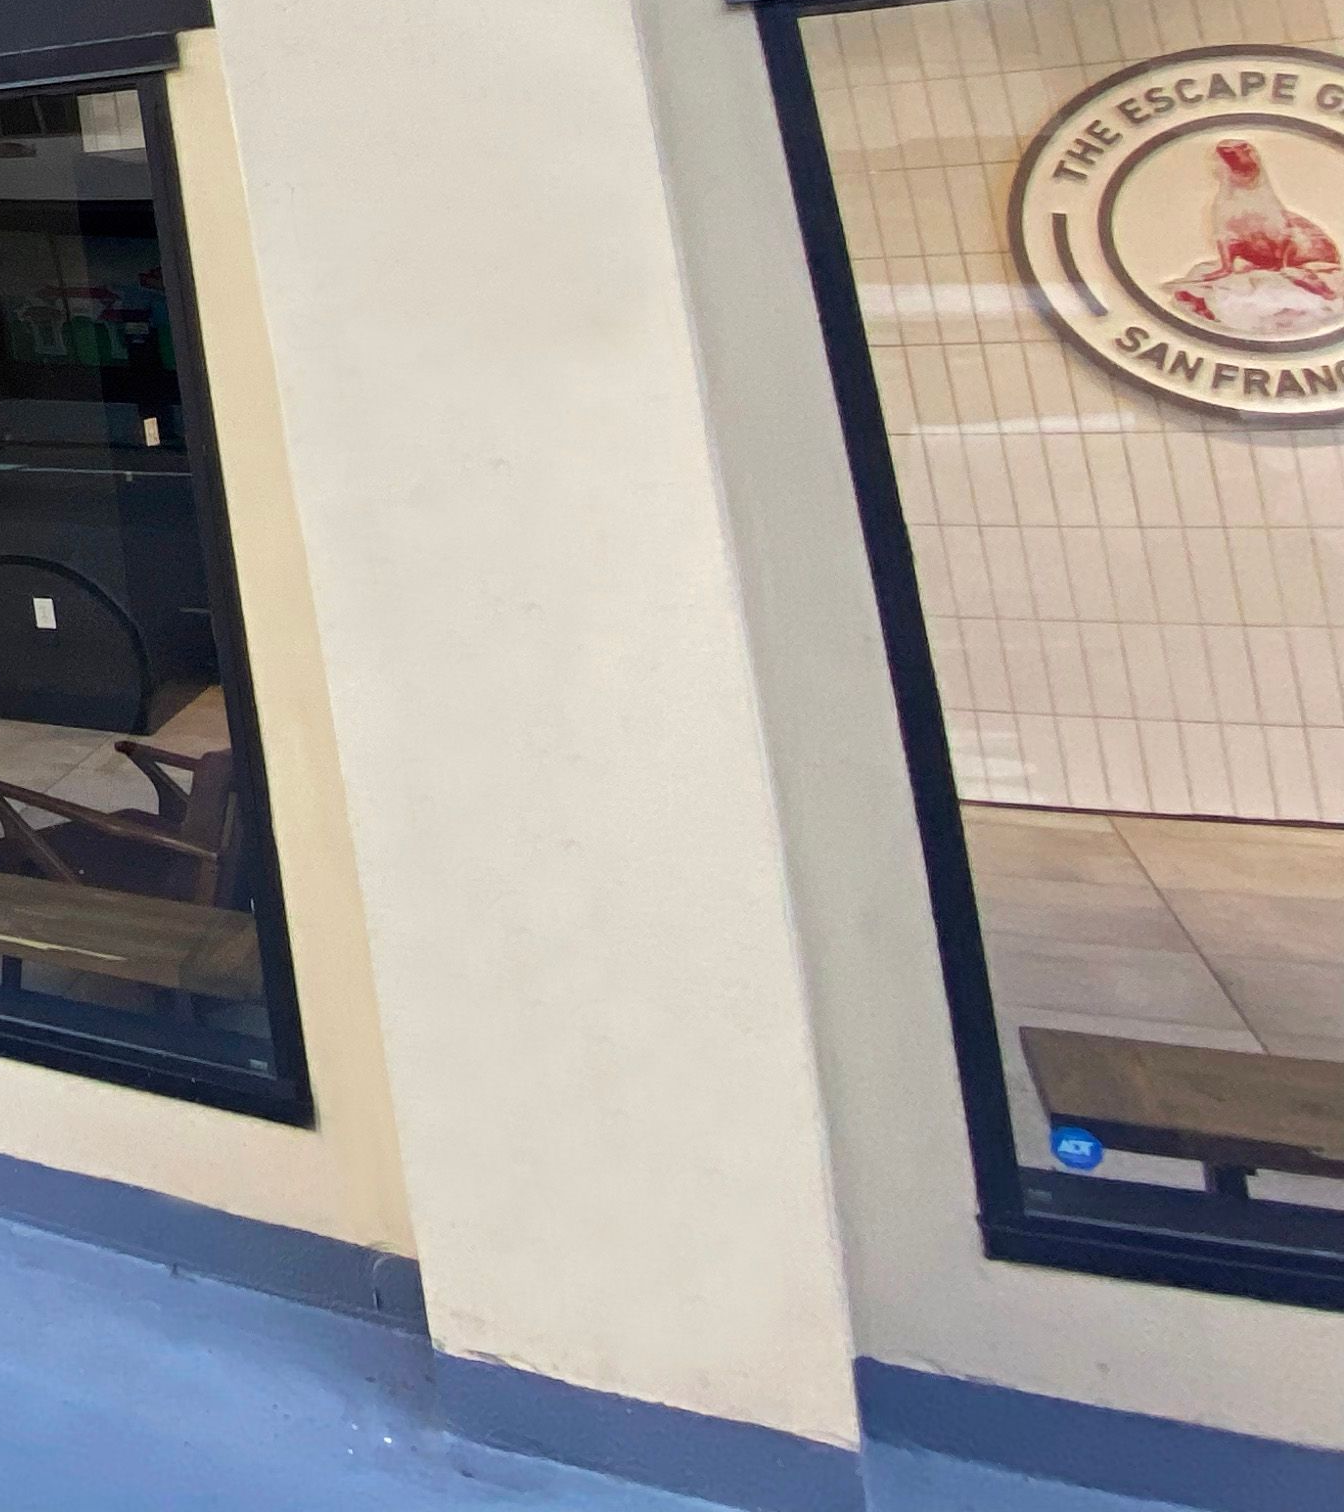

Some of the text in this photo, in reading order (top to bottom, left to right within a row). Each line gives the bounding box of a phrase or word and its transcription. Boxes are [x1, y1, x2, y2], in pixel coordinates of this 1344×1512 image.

[1052, 119, 1123, 183] THE
[1117, 71, 1299, 125] ESCAPE
[1115, 326, 1207, 382] SAN
